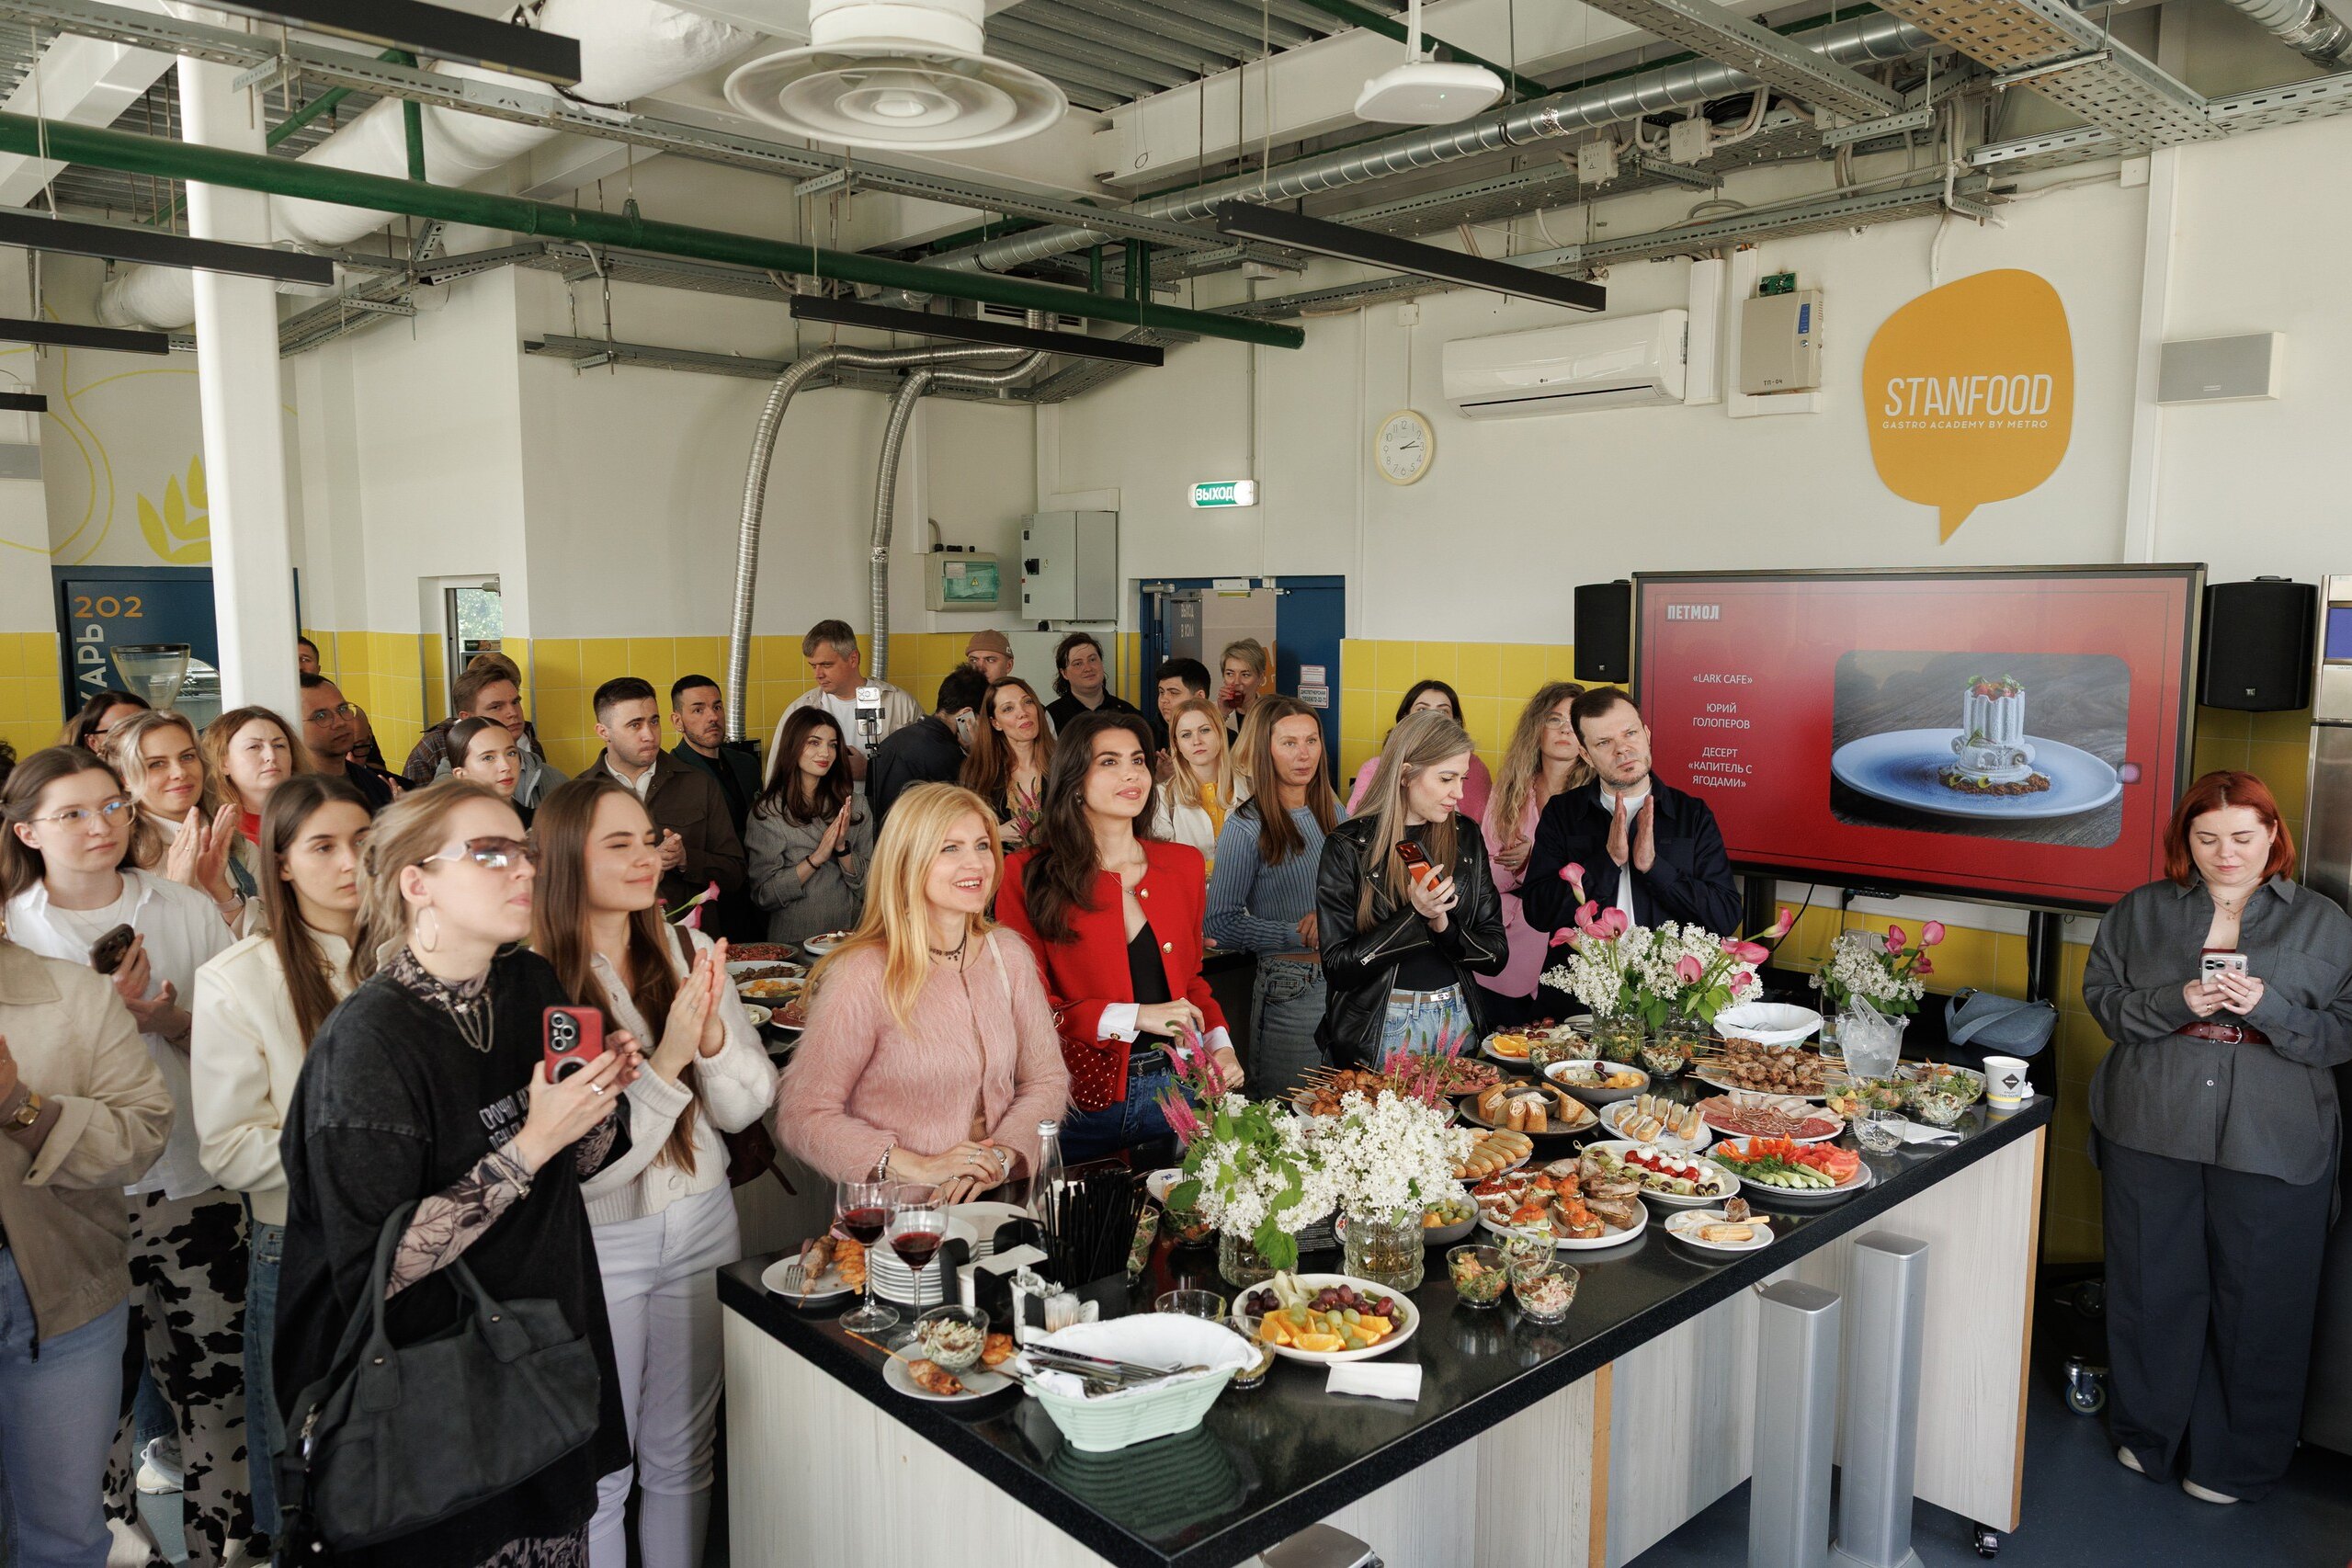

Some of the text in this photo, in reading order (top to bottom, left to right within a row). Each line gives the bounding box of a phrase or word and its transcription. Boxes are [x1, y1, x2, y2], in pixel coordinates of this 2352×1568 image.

[1885, 374, 2052, 416] STANFOOD
[1882, 420, 2049, 429] GASTRO ACADEMY BY METRO
[1196, 486, 1234, 501] ВЫХОД
[74, 596, 143, 619] 202
[1667, 605, 1720, 620] ПЕТМОЛ
[1693, 674, 1753, 685] «LARK CAFE»
[1706, 702, 1737, 714] ЮРИЙ
[1693, 717, 1750, 729] ГОЛОПЕРОВ
[1702, 747, 1738, 758] ДЕСЕРТ
[1688, 762, 1753, 774] «КАПИТЕЛЬ С
[1692, 776, 1746, 788] ЯГОДАМИ»
